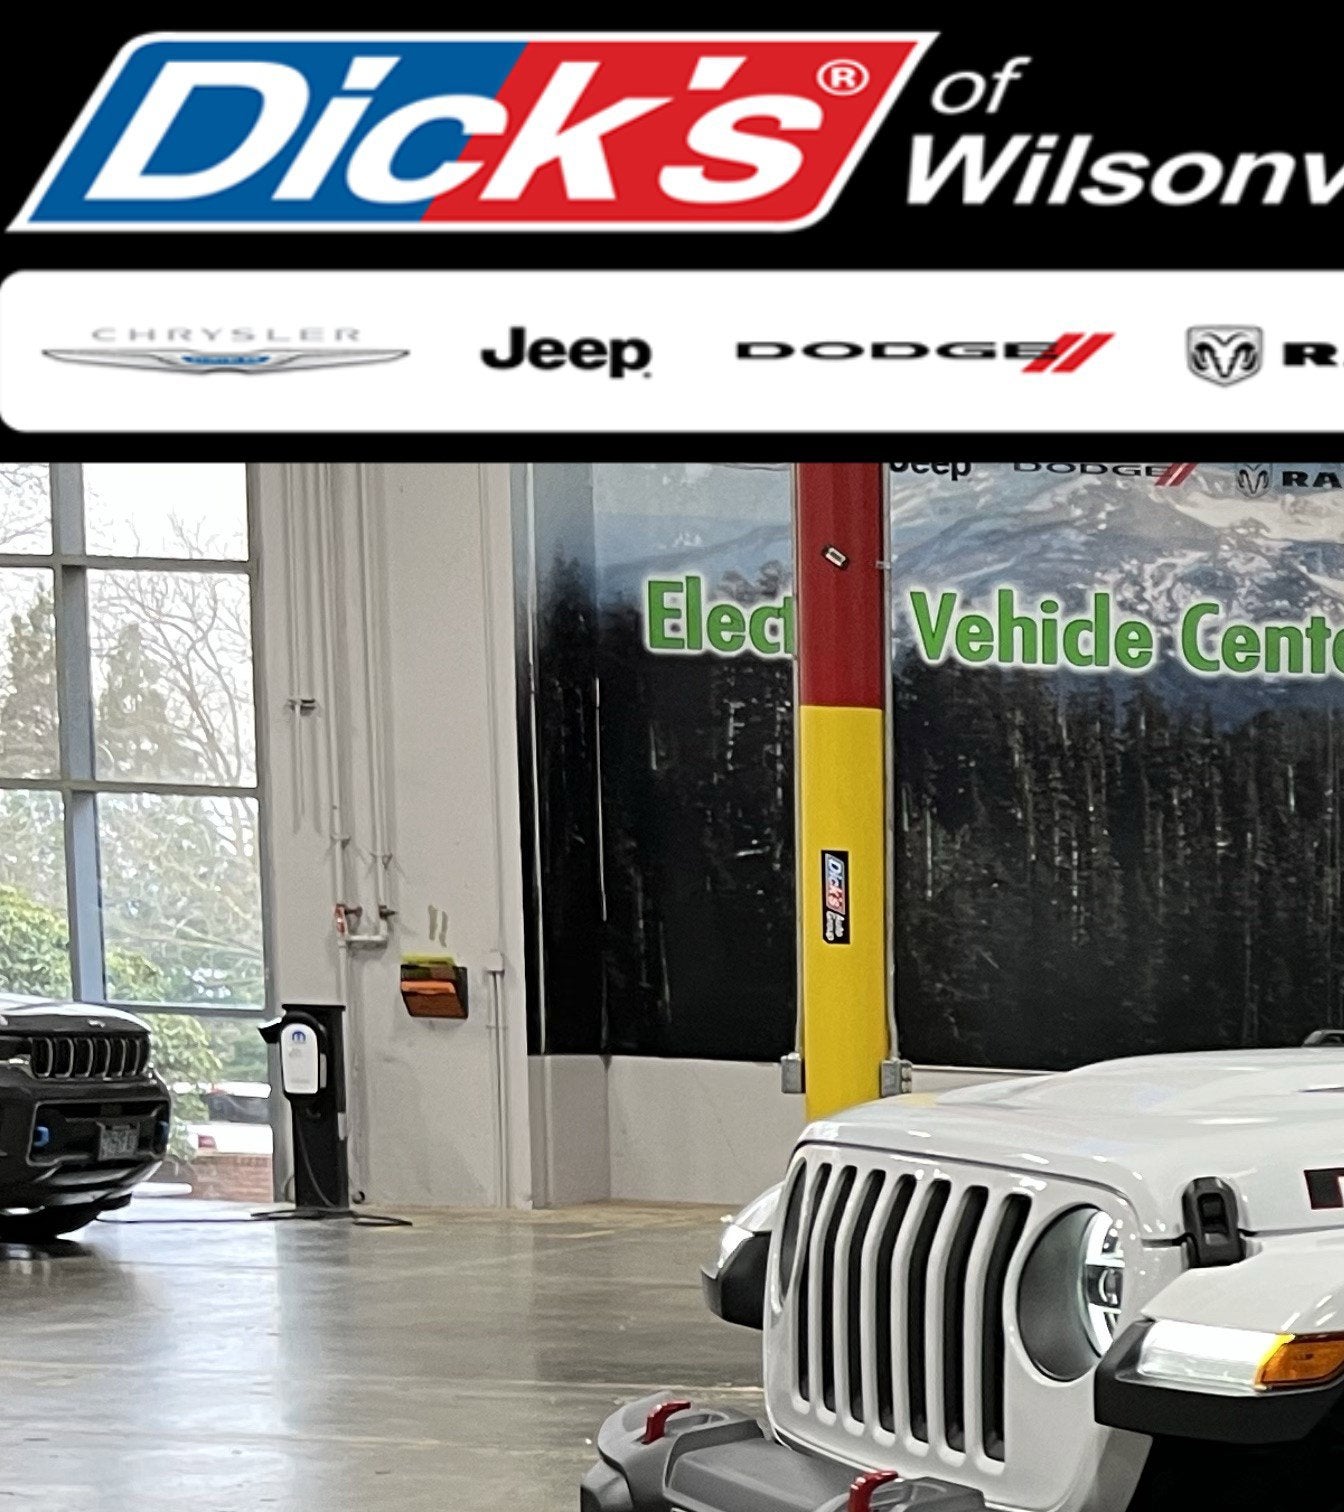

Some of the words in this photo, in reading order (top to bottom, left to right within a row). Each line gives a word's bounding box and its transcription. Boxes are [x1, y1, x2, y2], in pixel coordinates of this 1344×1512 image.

[1013, 462, 1174, 478] DODGE
[647, 575, 794, 655] Elect
[910, 588, 1154, 669] Vehicle
